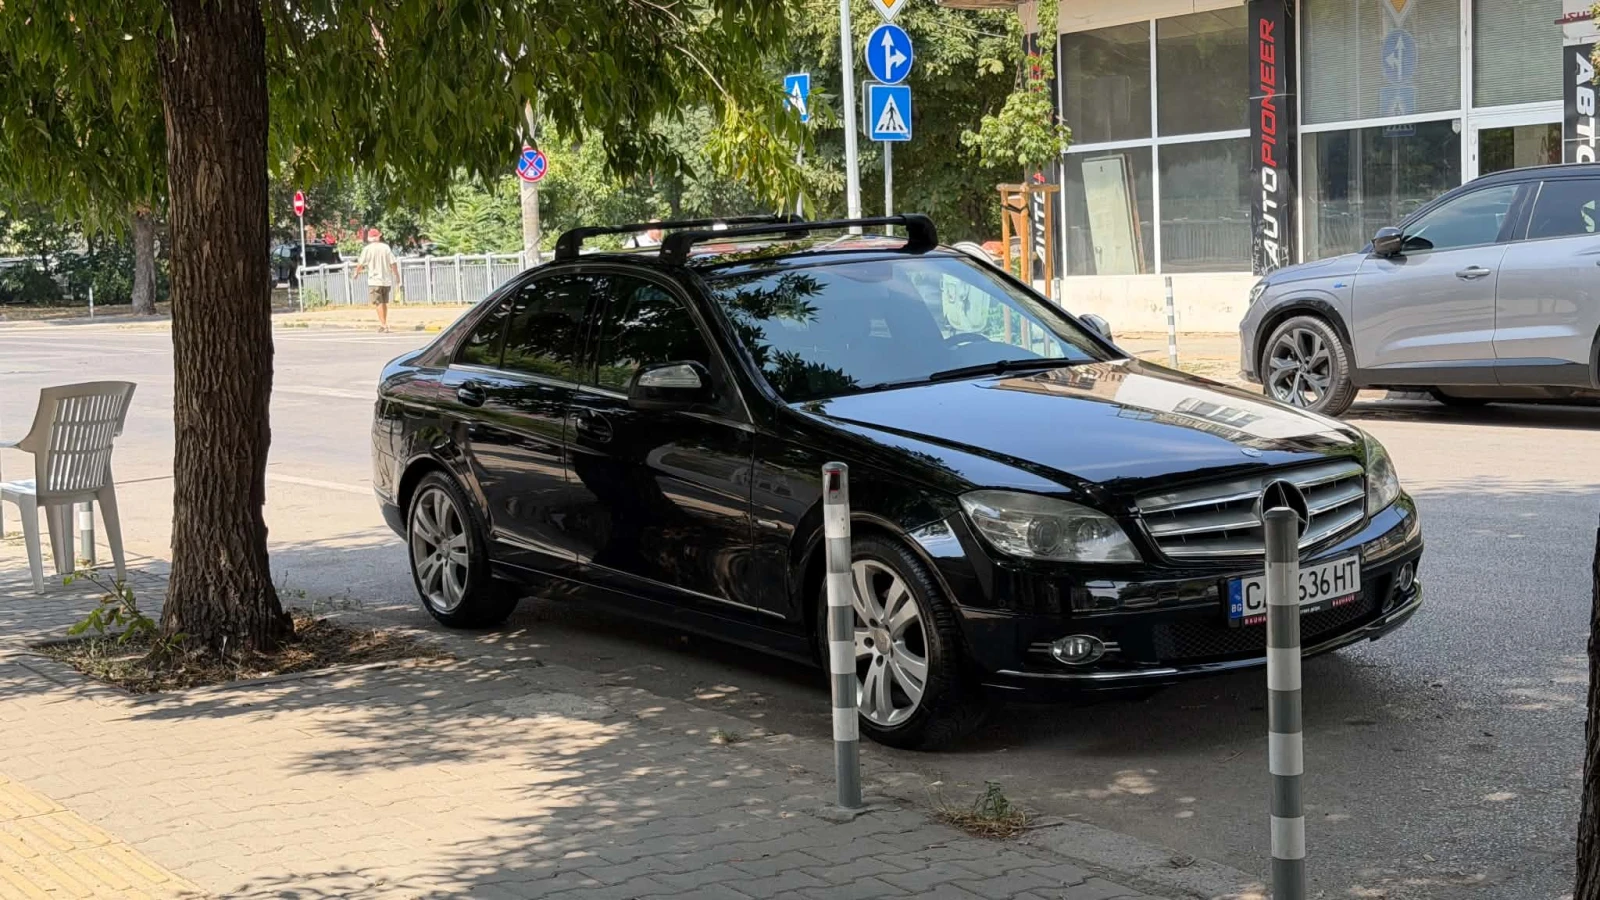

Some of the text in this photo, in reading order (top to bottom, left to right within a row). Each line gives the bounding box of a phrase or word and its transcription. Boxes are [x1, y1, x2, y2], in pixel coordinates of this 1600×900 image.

[1299, 567, 1330, 601] 636
[1231, 603, 1243, 613] BG
[1244, 616, 1266, 625] BAUHA
